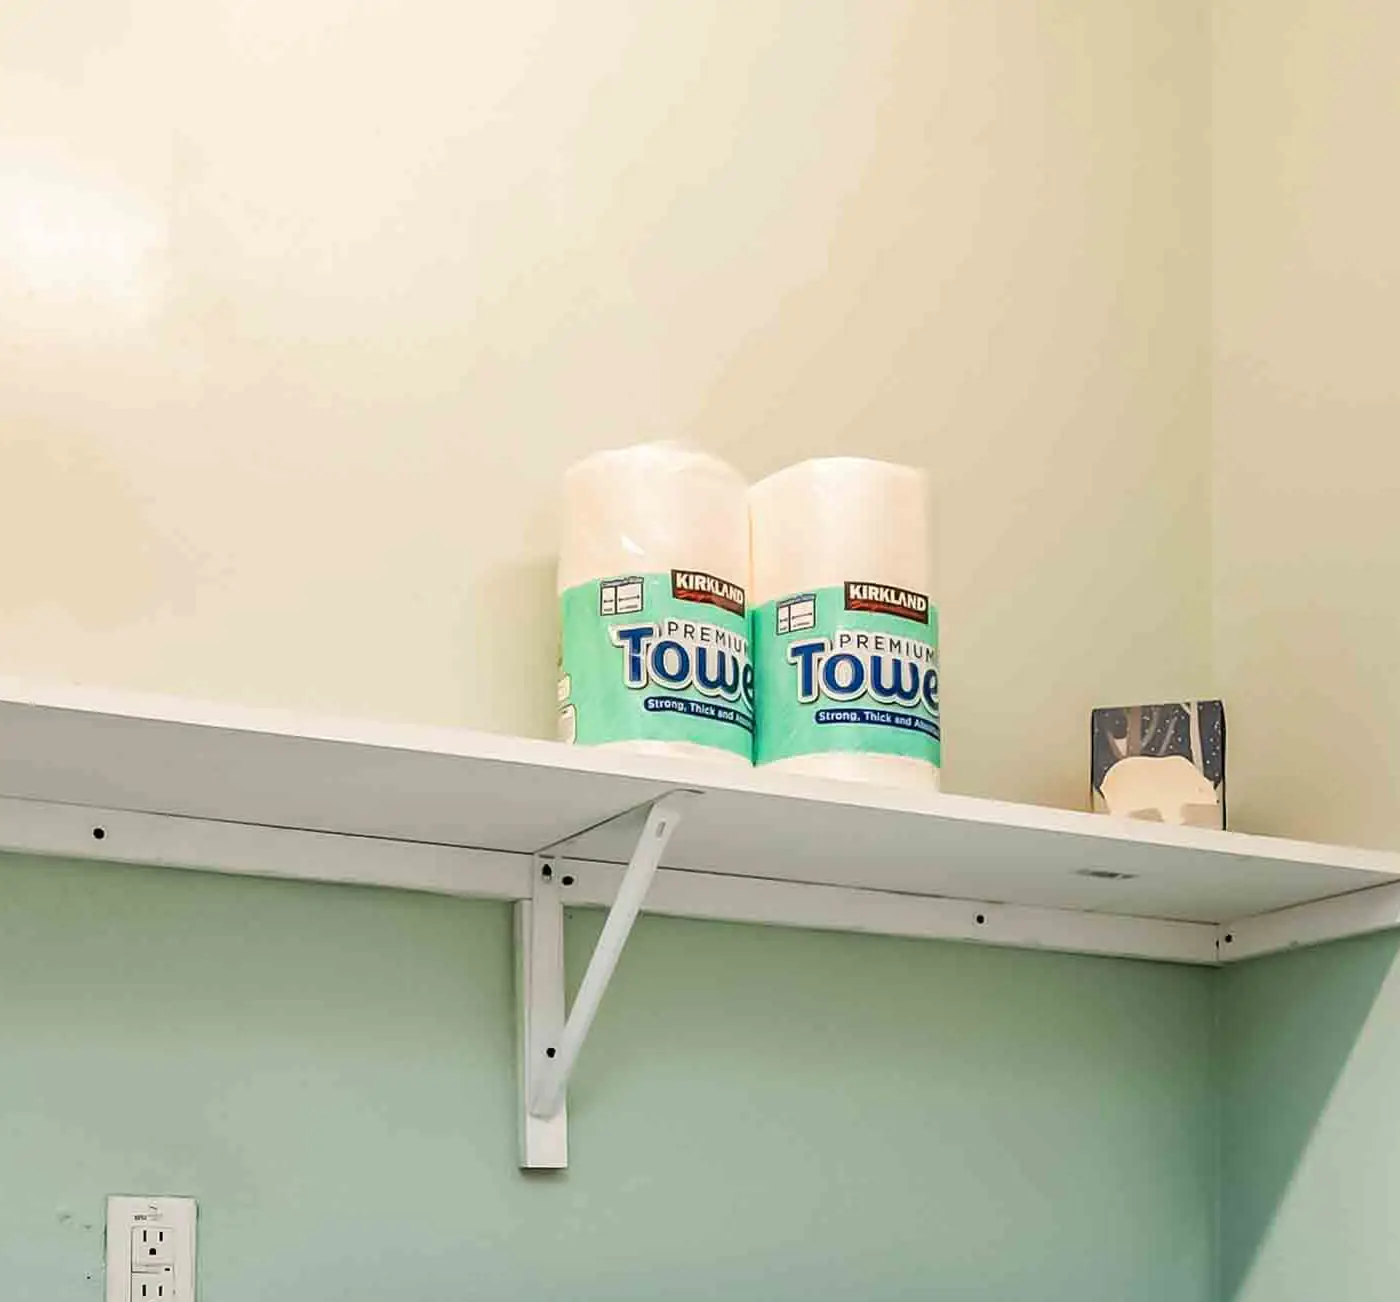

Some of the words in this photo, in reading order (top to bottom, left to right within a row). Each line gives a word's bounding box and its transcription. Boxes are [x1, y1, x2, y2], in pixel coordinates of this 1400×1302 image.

[675, 572, 744, 604] KIRKLAND
[850, 584, 927, 612] KIRKLAND
[647, 698, 687, 713] Strong,
[690, 702, 716, 717] Thick
[717, 710, 734, 721] and
[819, 711, 861, 722] Strong,
[864, 711, 892, 723] Thick
[894, 717, 912, 727] and
